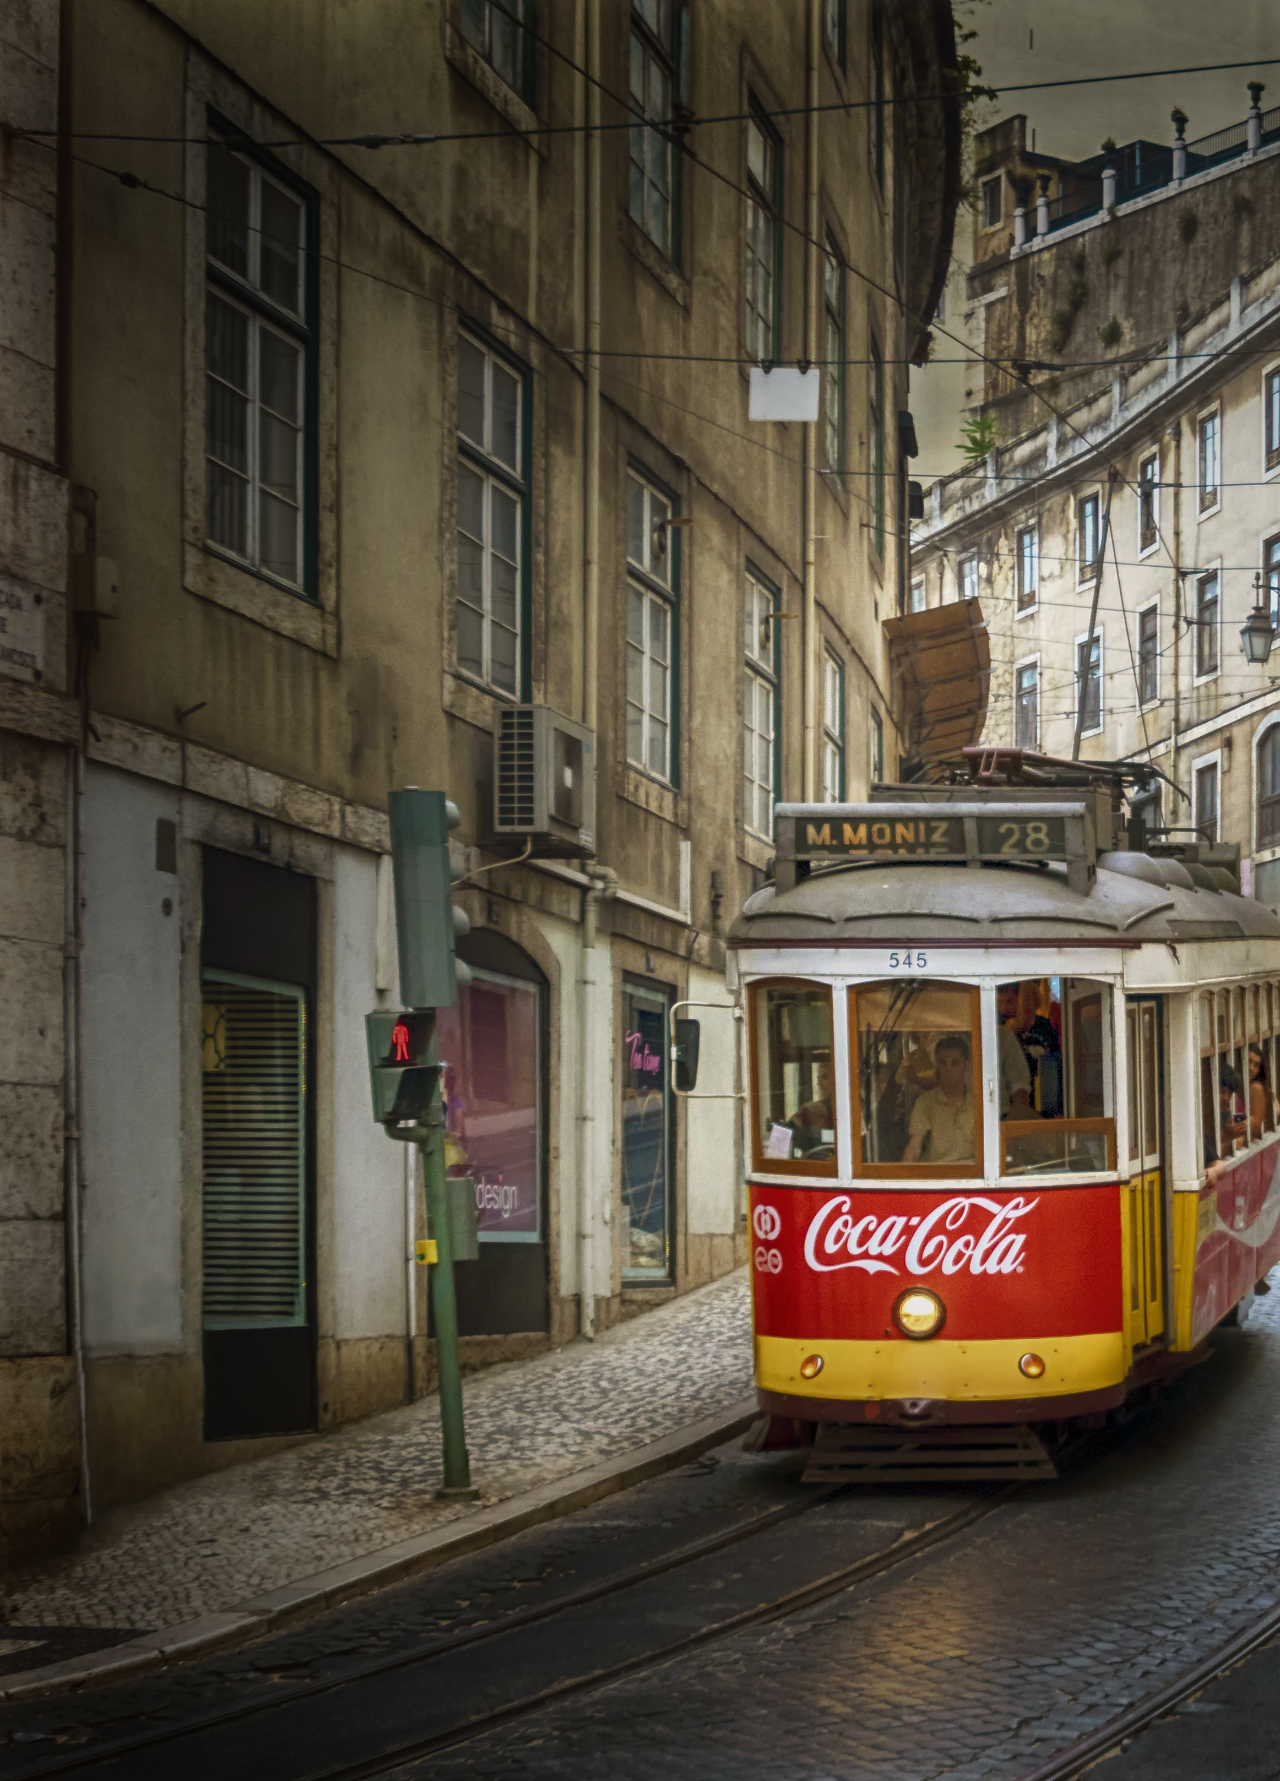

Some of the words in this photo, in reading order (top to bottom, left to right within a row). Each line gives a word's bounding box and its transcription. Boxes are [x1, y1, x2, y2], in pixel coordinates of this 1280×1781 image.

[998, 821, 1051, 852] 28
[888, 952, 928, 968] 545
[804, 1195, 1040, 1275] Coca-Cola
